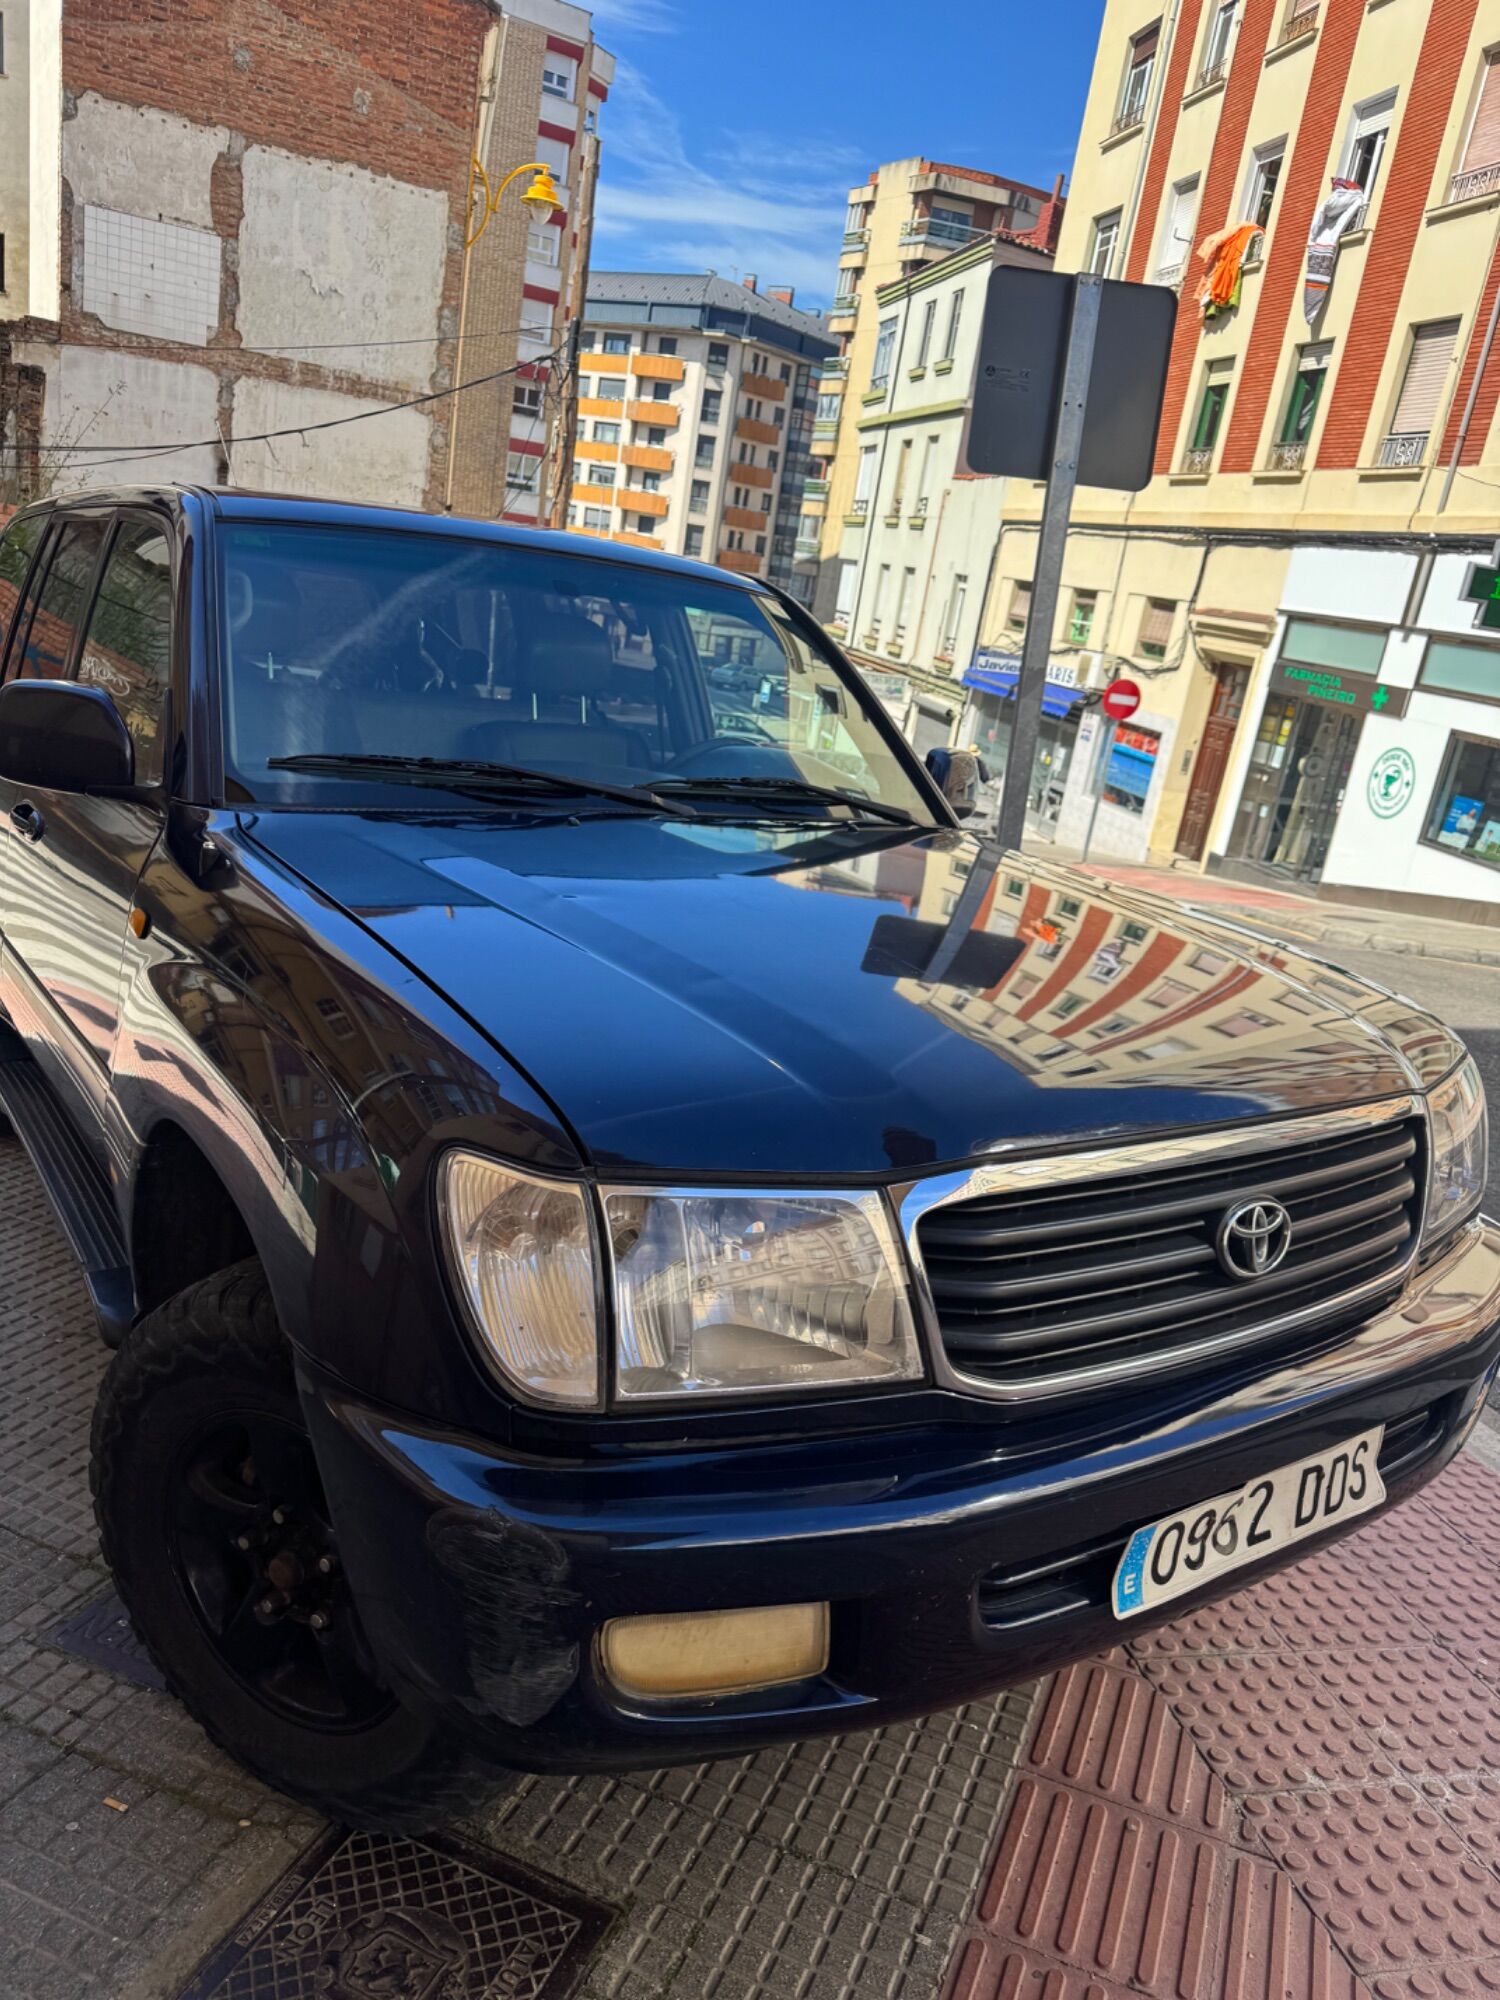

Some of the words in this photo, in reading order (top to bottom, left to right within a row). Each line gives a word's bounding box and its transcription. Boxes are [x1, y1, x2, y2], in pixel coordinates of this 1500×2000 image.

[978, 659, 1021, 674] Javie
[1284, 667, 1342, 688] FARMACIA
[1150, 1479, 1274, 1586] 0962
[1294, 1440, 1369, 1529] DDS
[1123, 1573, 1137, 1595] E
